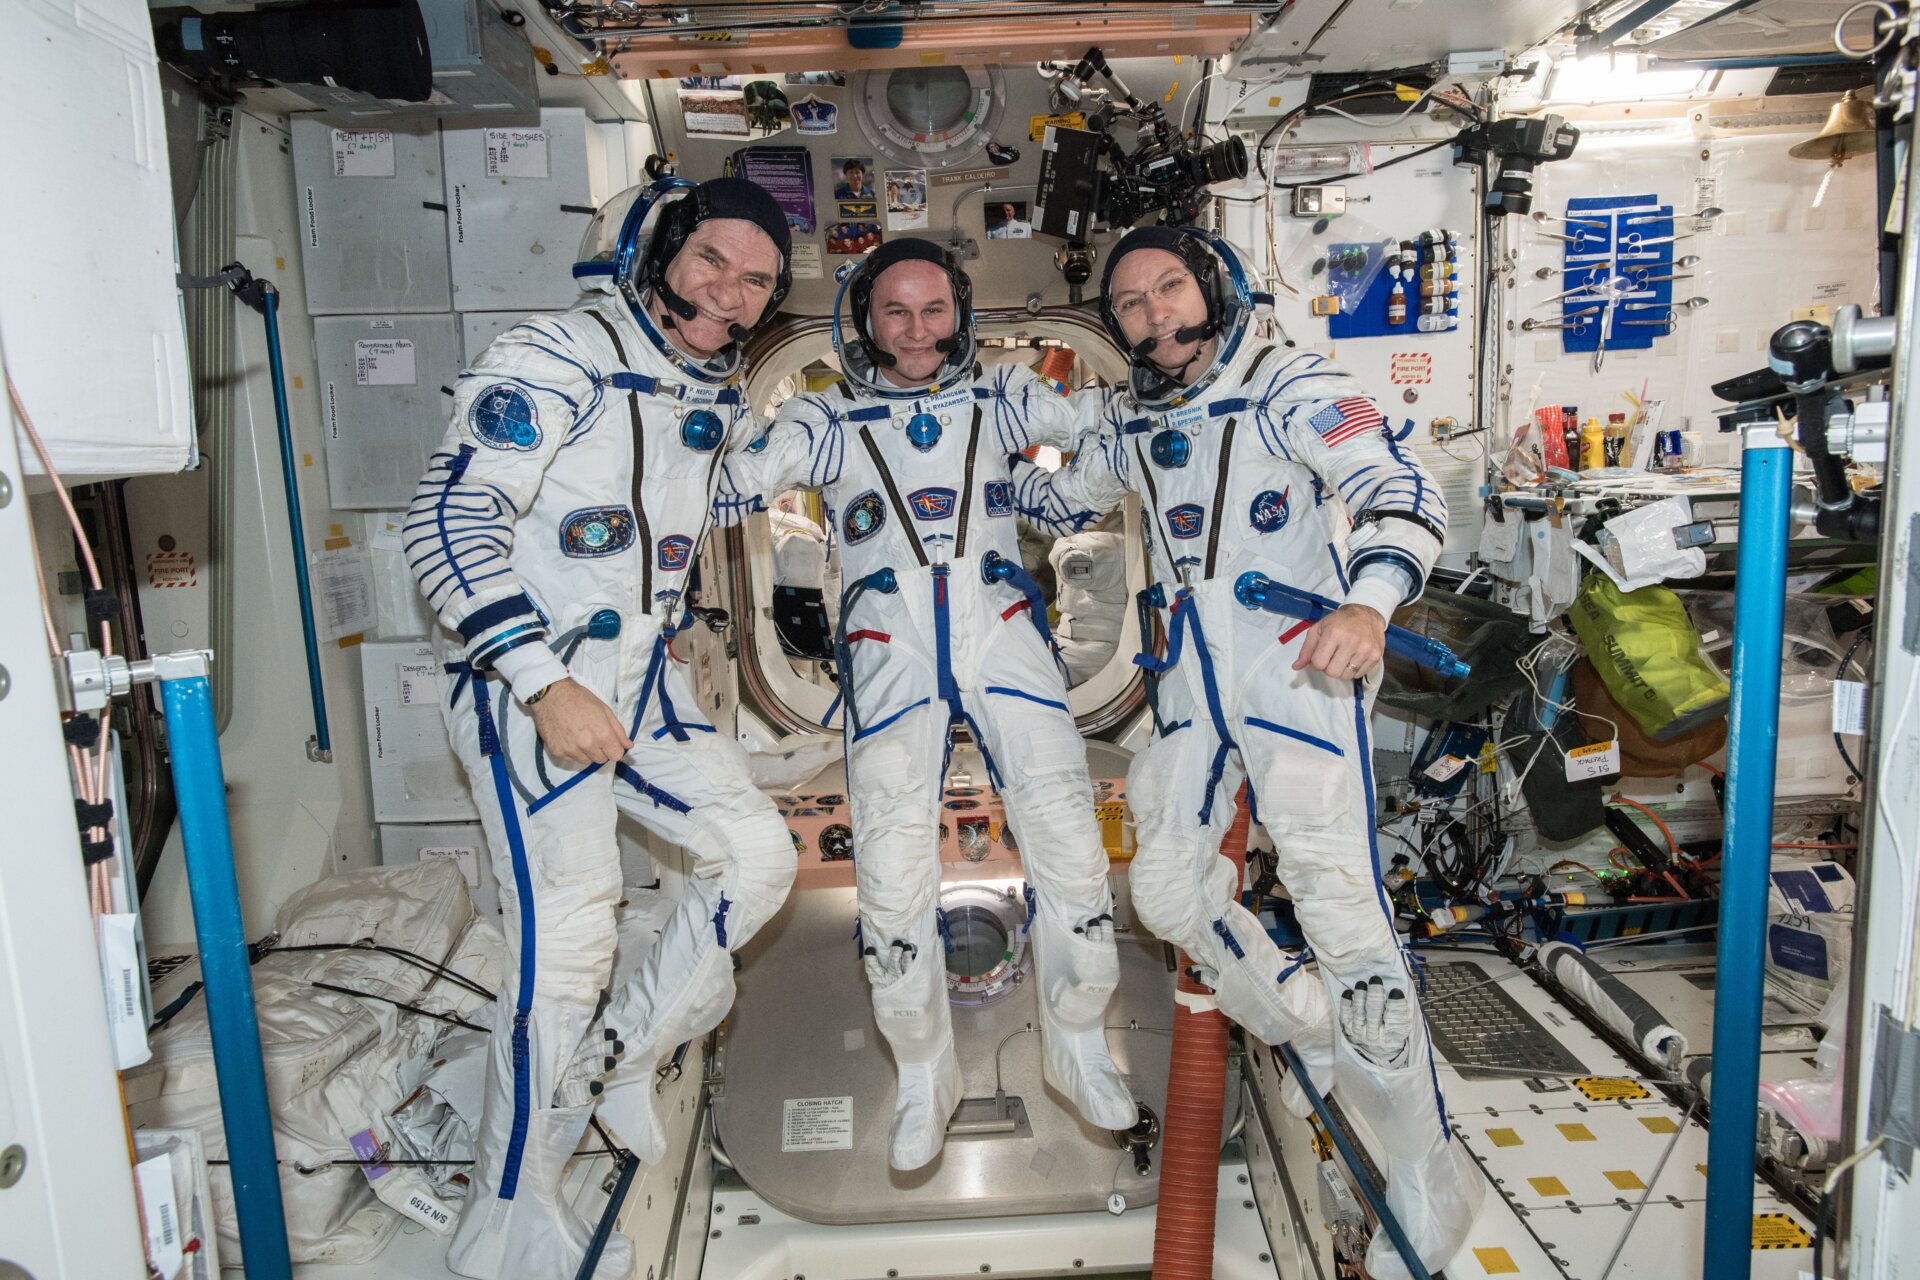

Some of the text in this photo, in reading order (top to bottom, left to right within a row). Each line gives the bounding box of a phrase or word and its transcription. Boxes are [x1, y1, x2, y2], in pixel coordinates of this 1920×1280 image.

[369, 131, 390, 144] FISH
[489, 131, 508, 140] SIDE
[942, 171, 996, 184] FRANK CALDEIRO
[306, 187, 317, 247] Foam Food Locker
[453, 185, 464, 243] Foam Food Locker
[1176, 406, 1203, 418] BRESNIK
[1254, 503, 1287, 525] NASA
[1581, 595, 1600, 621] SEA
[1603, 634, 1648, 688] SUMMIT
[410, 1196, 448, 1224] S/N 2159
